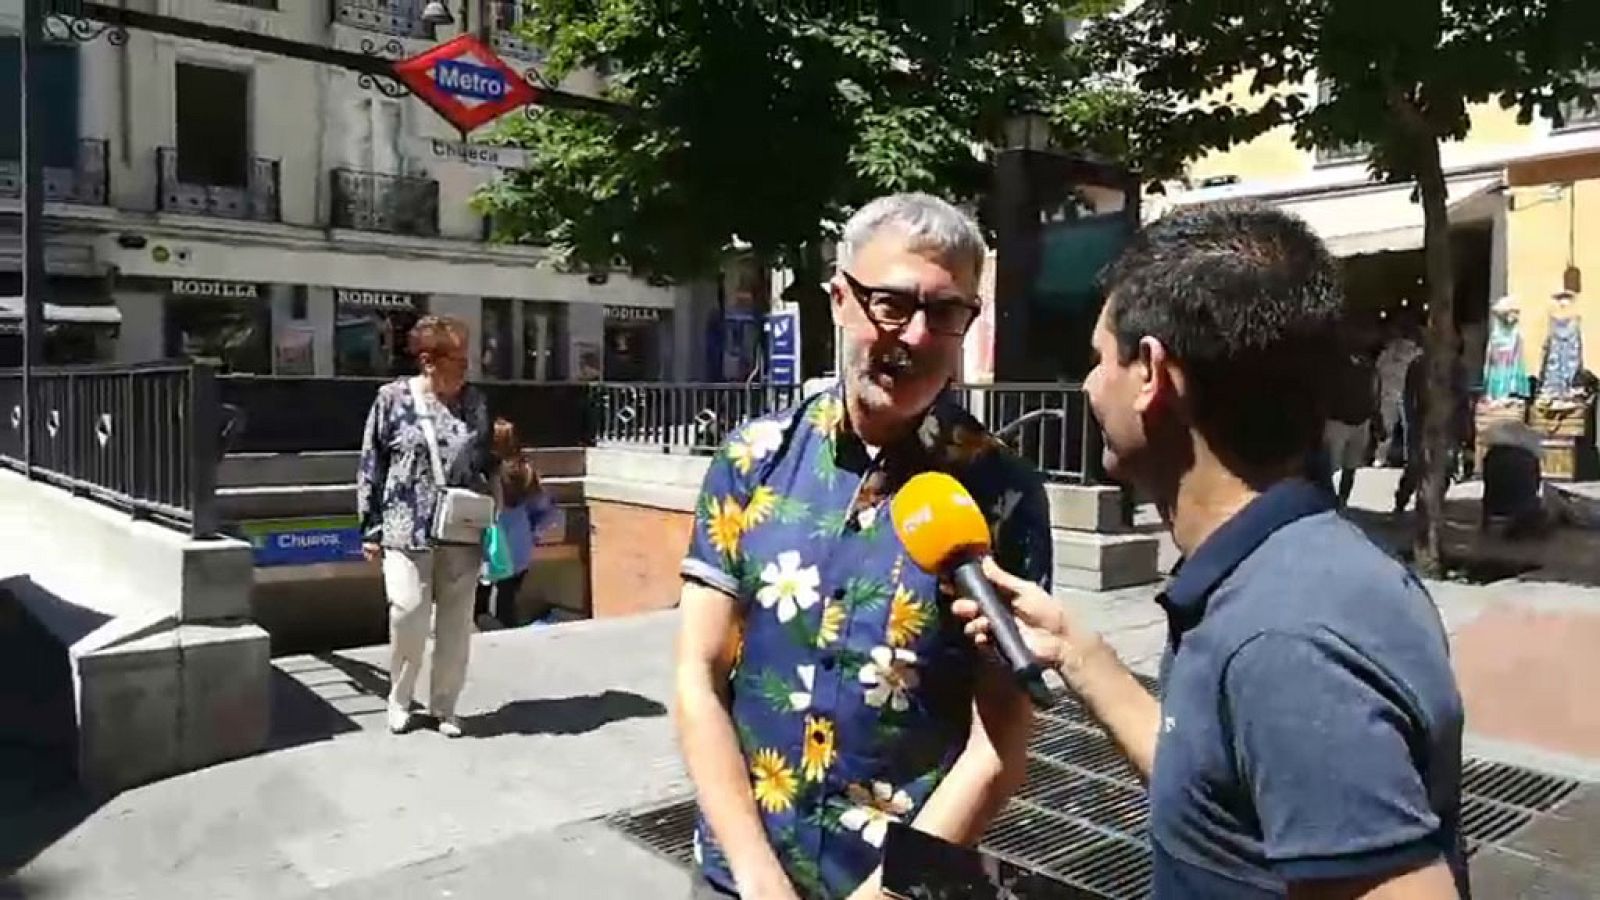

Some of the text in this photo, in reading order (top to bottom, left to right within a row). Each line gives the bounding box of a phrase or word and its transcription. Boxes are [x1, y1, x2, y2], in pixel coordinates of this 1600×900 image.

[438, 65, 501, 96] Metro
[432, 139, 498, 162] Chueca
[172, 280, 258, 298] RODILLA
